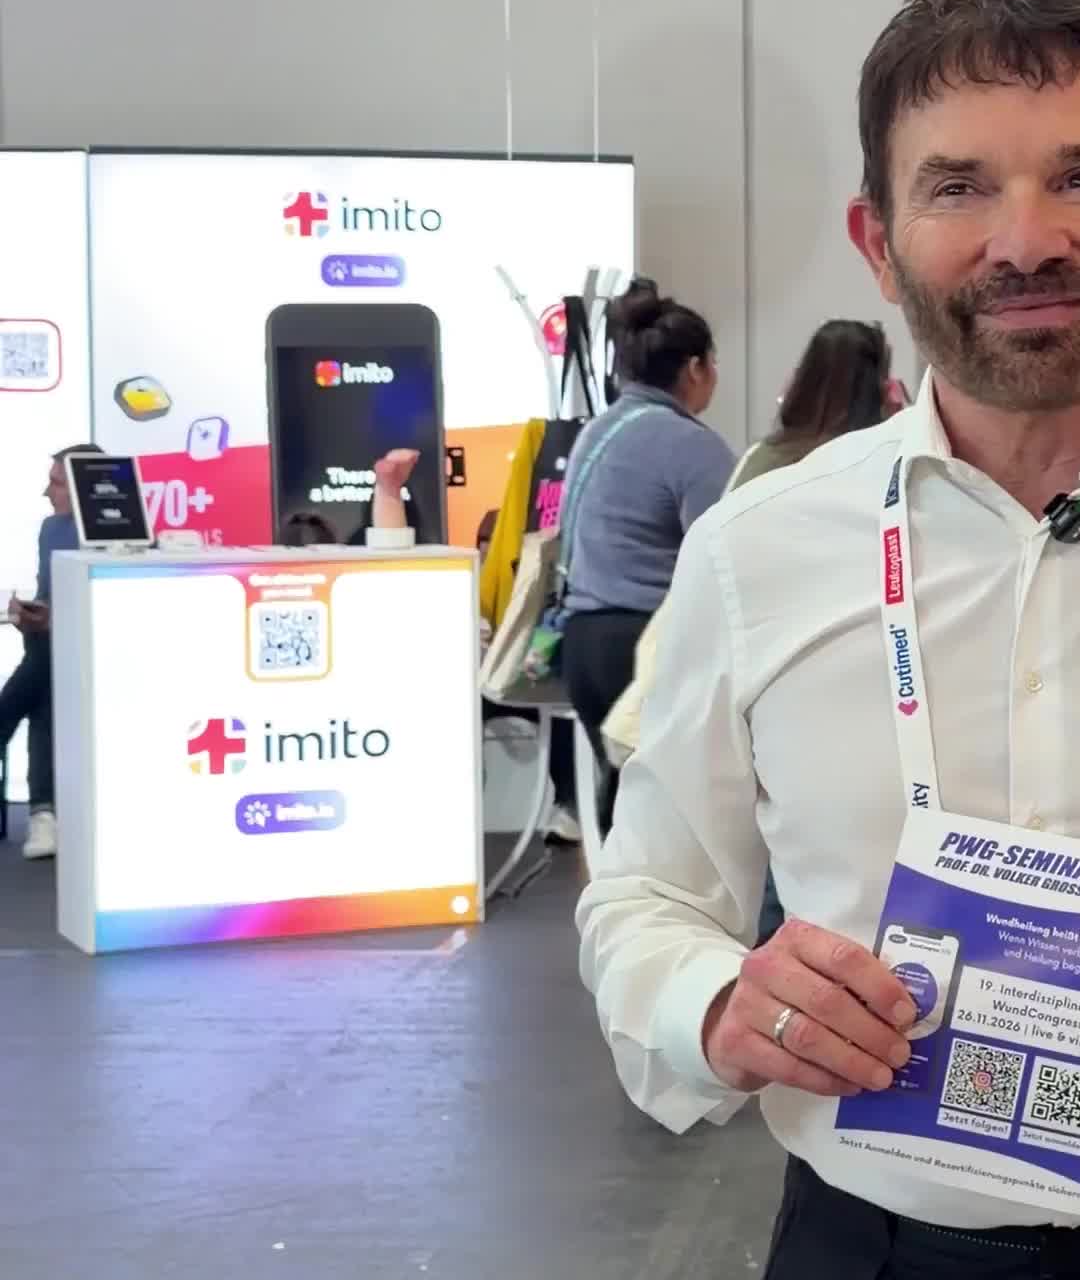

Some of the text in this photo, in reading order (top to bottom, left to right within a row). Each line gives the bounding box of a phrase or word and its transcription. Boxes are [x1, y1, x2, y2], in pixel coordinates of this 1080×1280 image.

[342, 197, 442, 232] imito
[887, 533, 902, 598] Leukoplast
[264, 719, 391, 763] imito
[912, 782, 930, 808] ity
[935, 855, 967, 873] PROF.
[971, 863, 990, 878] DR.
[993, 867, 1041, 889] VOLKER
[986, 912, 1050, 937] Wundheilung
[998, 930, 1026, 945] Wenn
[1028, 936, 1060, 952] Wissen
[1004, 949, 1022, 960] und
[1024, 951, 1060, 970] Heilung
[980, 979, 996, 993] 19.
[957, 1009, 1021, 1033] 26.11.2026
[1031, 1024, 1053, 1040] live
[1056, 1031, 1066, 1043] &
[943, 1113, 1009, 1135] Jetzt folgen!
[1022, 1130, 1043, 1142] Jetzt
[839, 1135, 862, 1149] Jetzt
[865, 1142, 913, 1161] Anmelden
[914, 1153, 932, 1166] und
